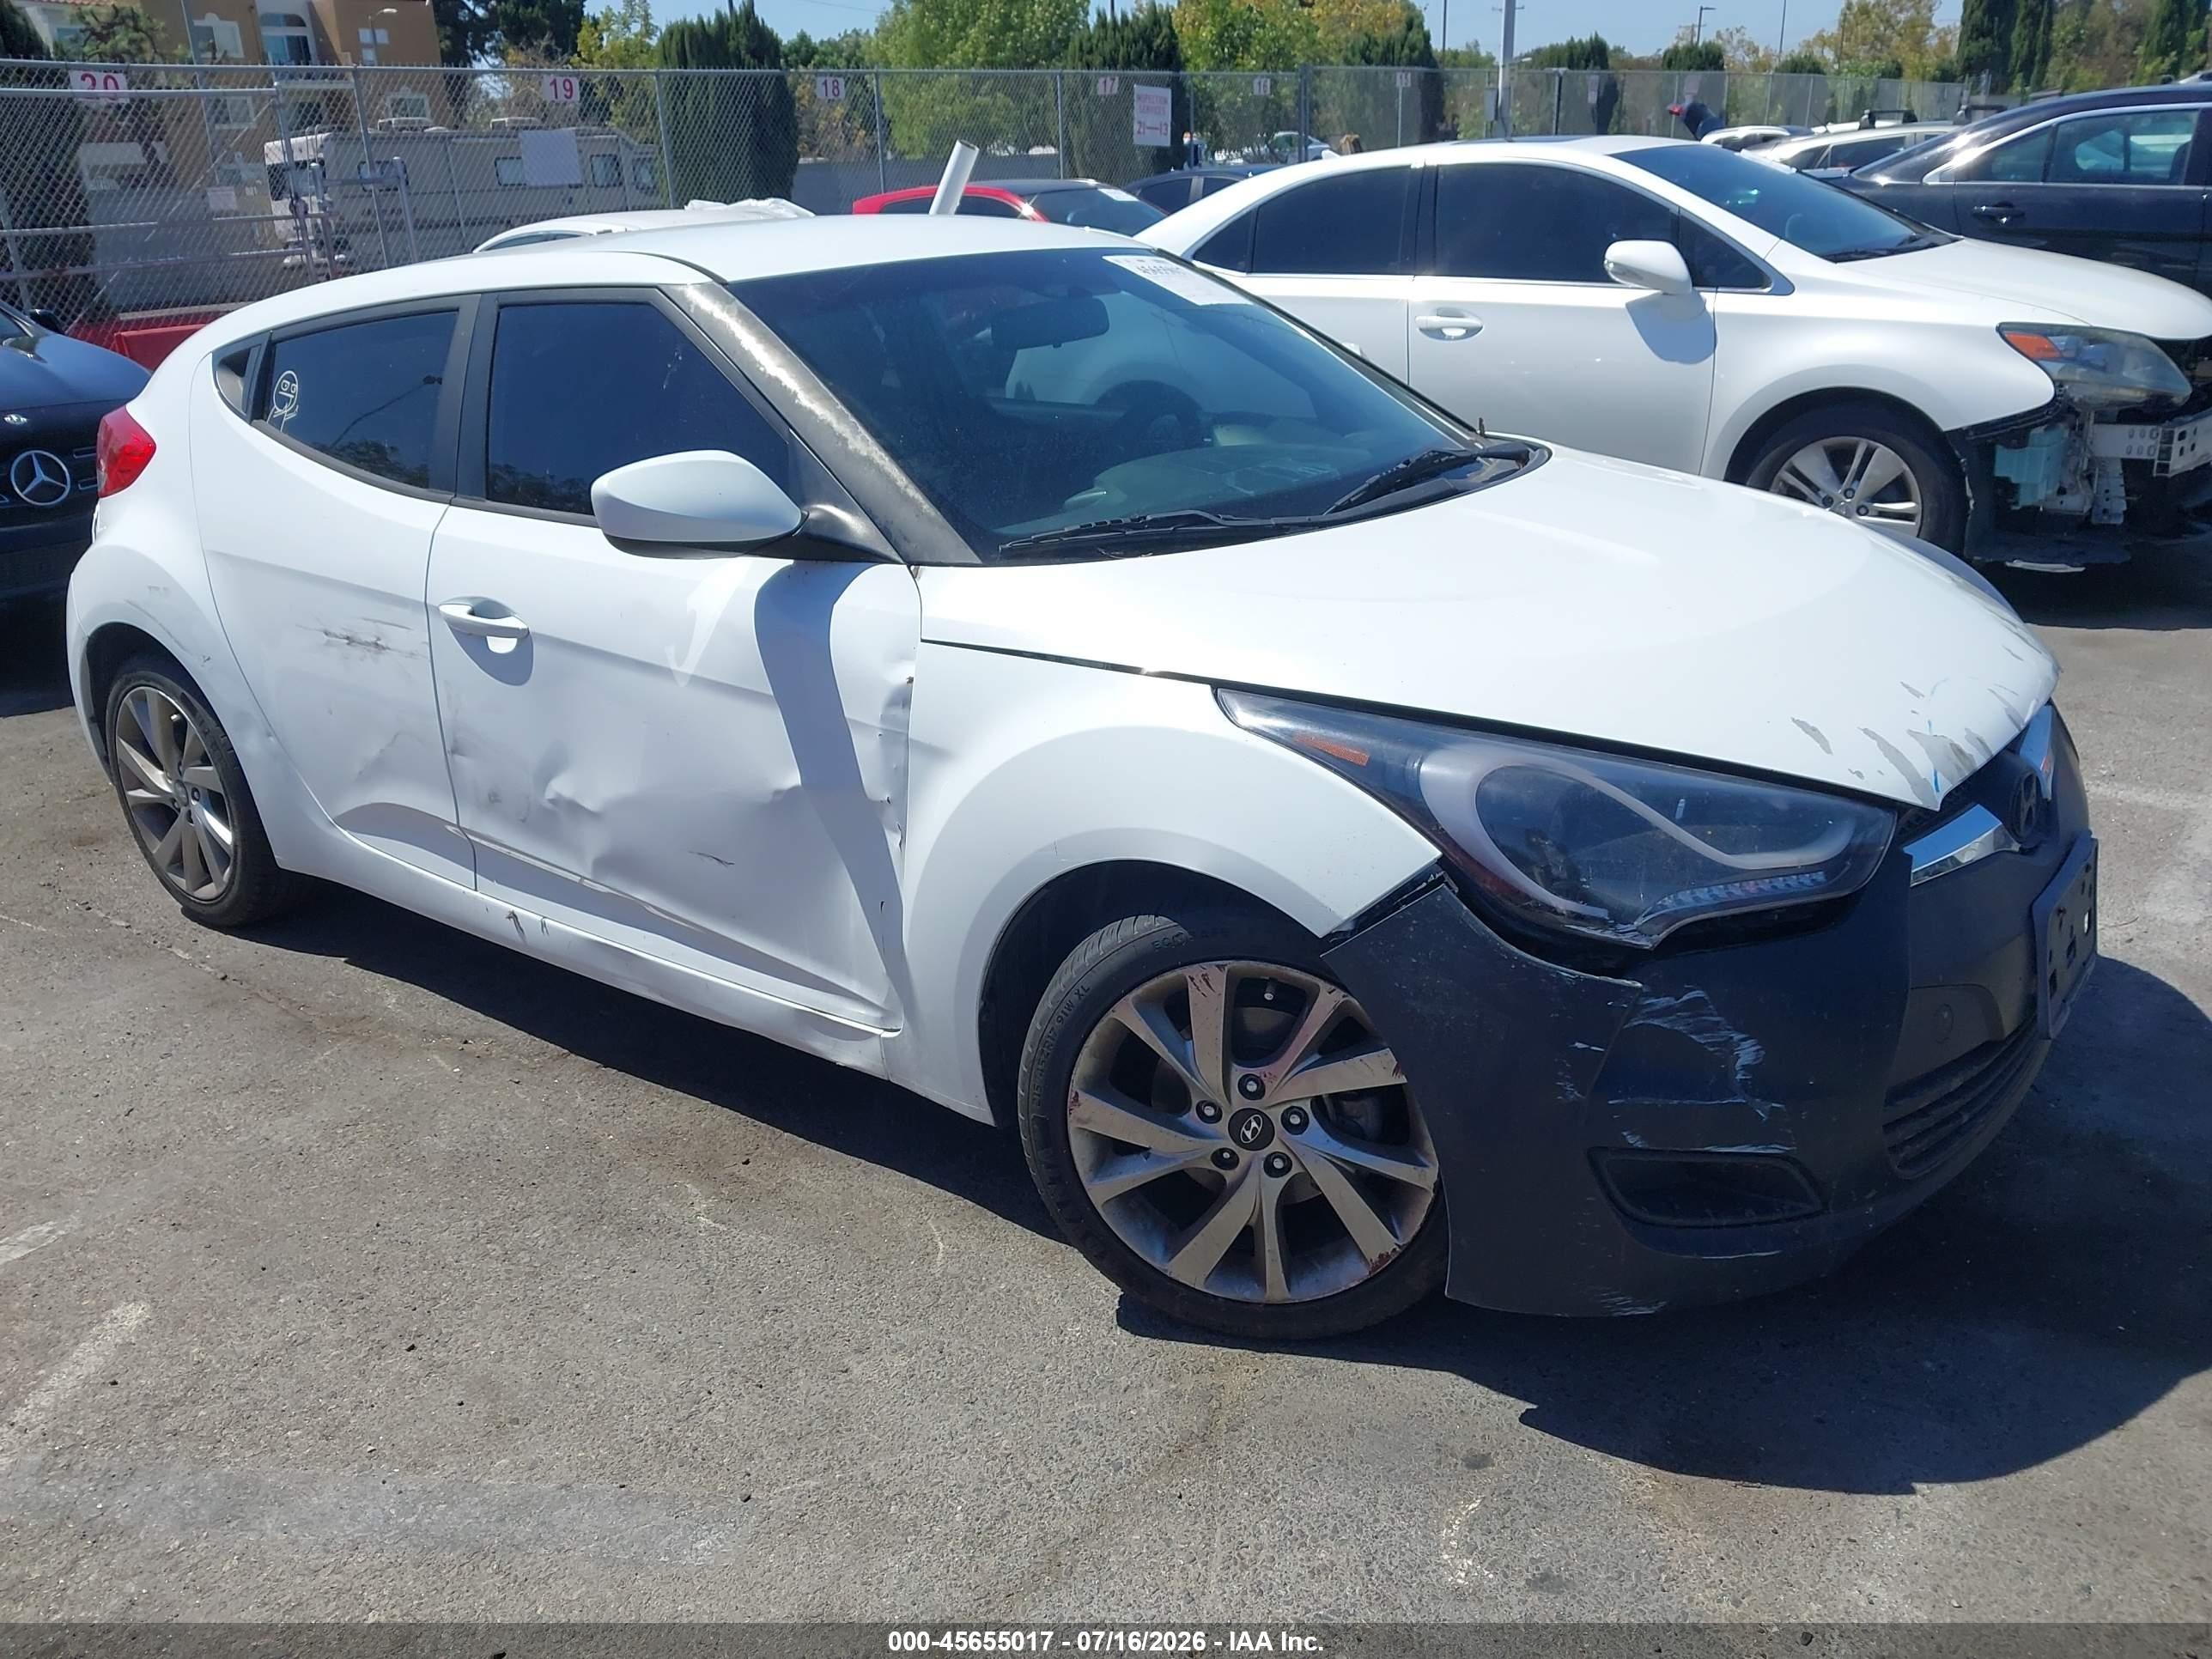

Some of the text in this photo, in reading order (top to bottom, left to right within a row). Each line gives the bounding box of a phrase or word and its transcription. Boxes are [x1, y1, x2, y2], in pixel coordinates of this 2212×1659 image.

[81, 72, 119, 100] 20
[550, 78, 573, 100] 19
[822, 79, 840, 97] 18
[1102, 77, 1115, 94] 17
[1073, 985, 1091, 1000] XL
